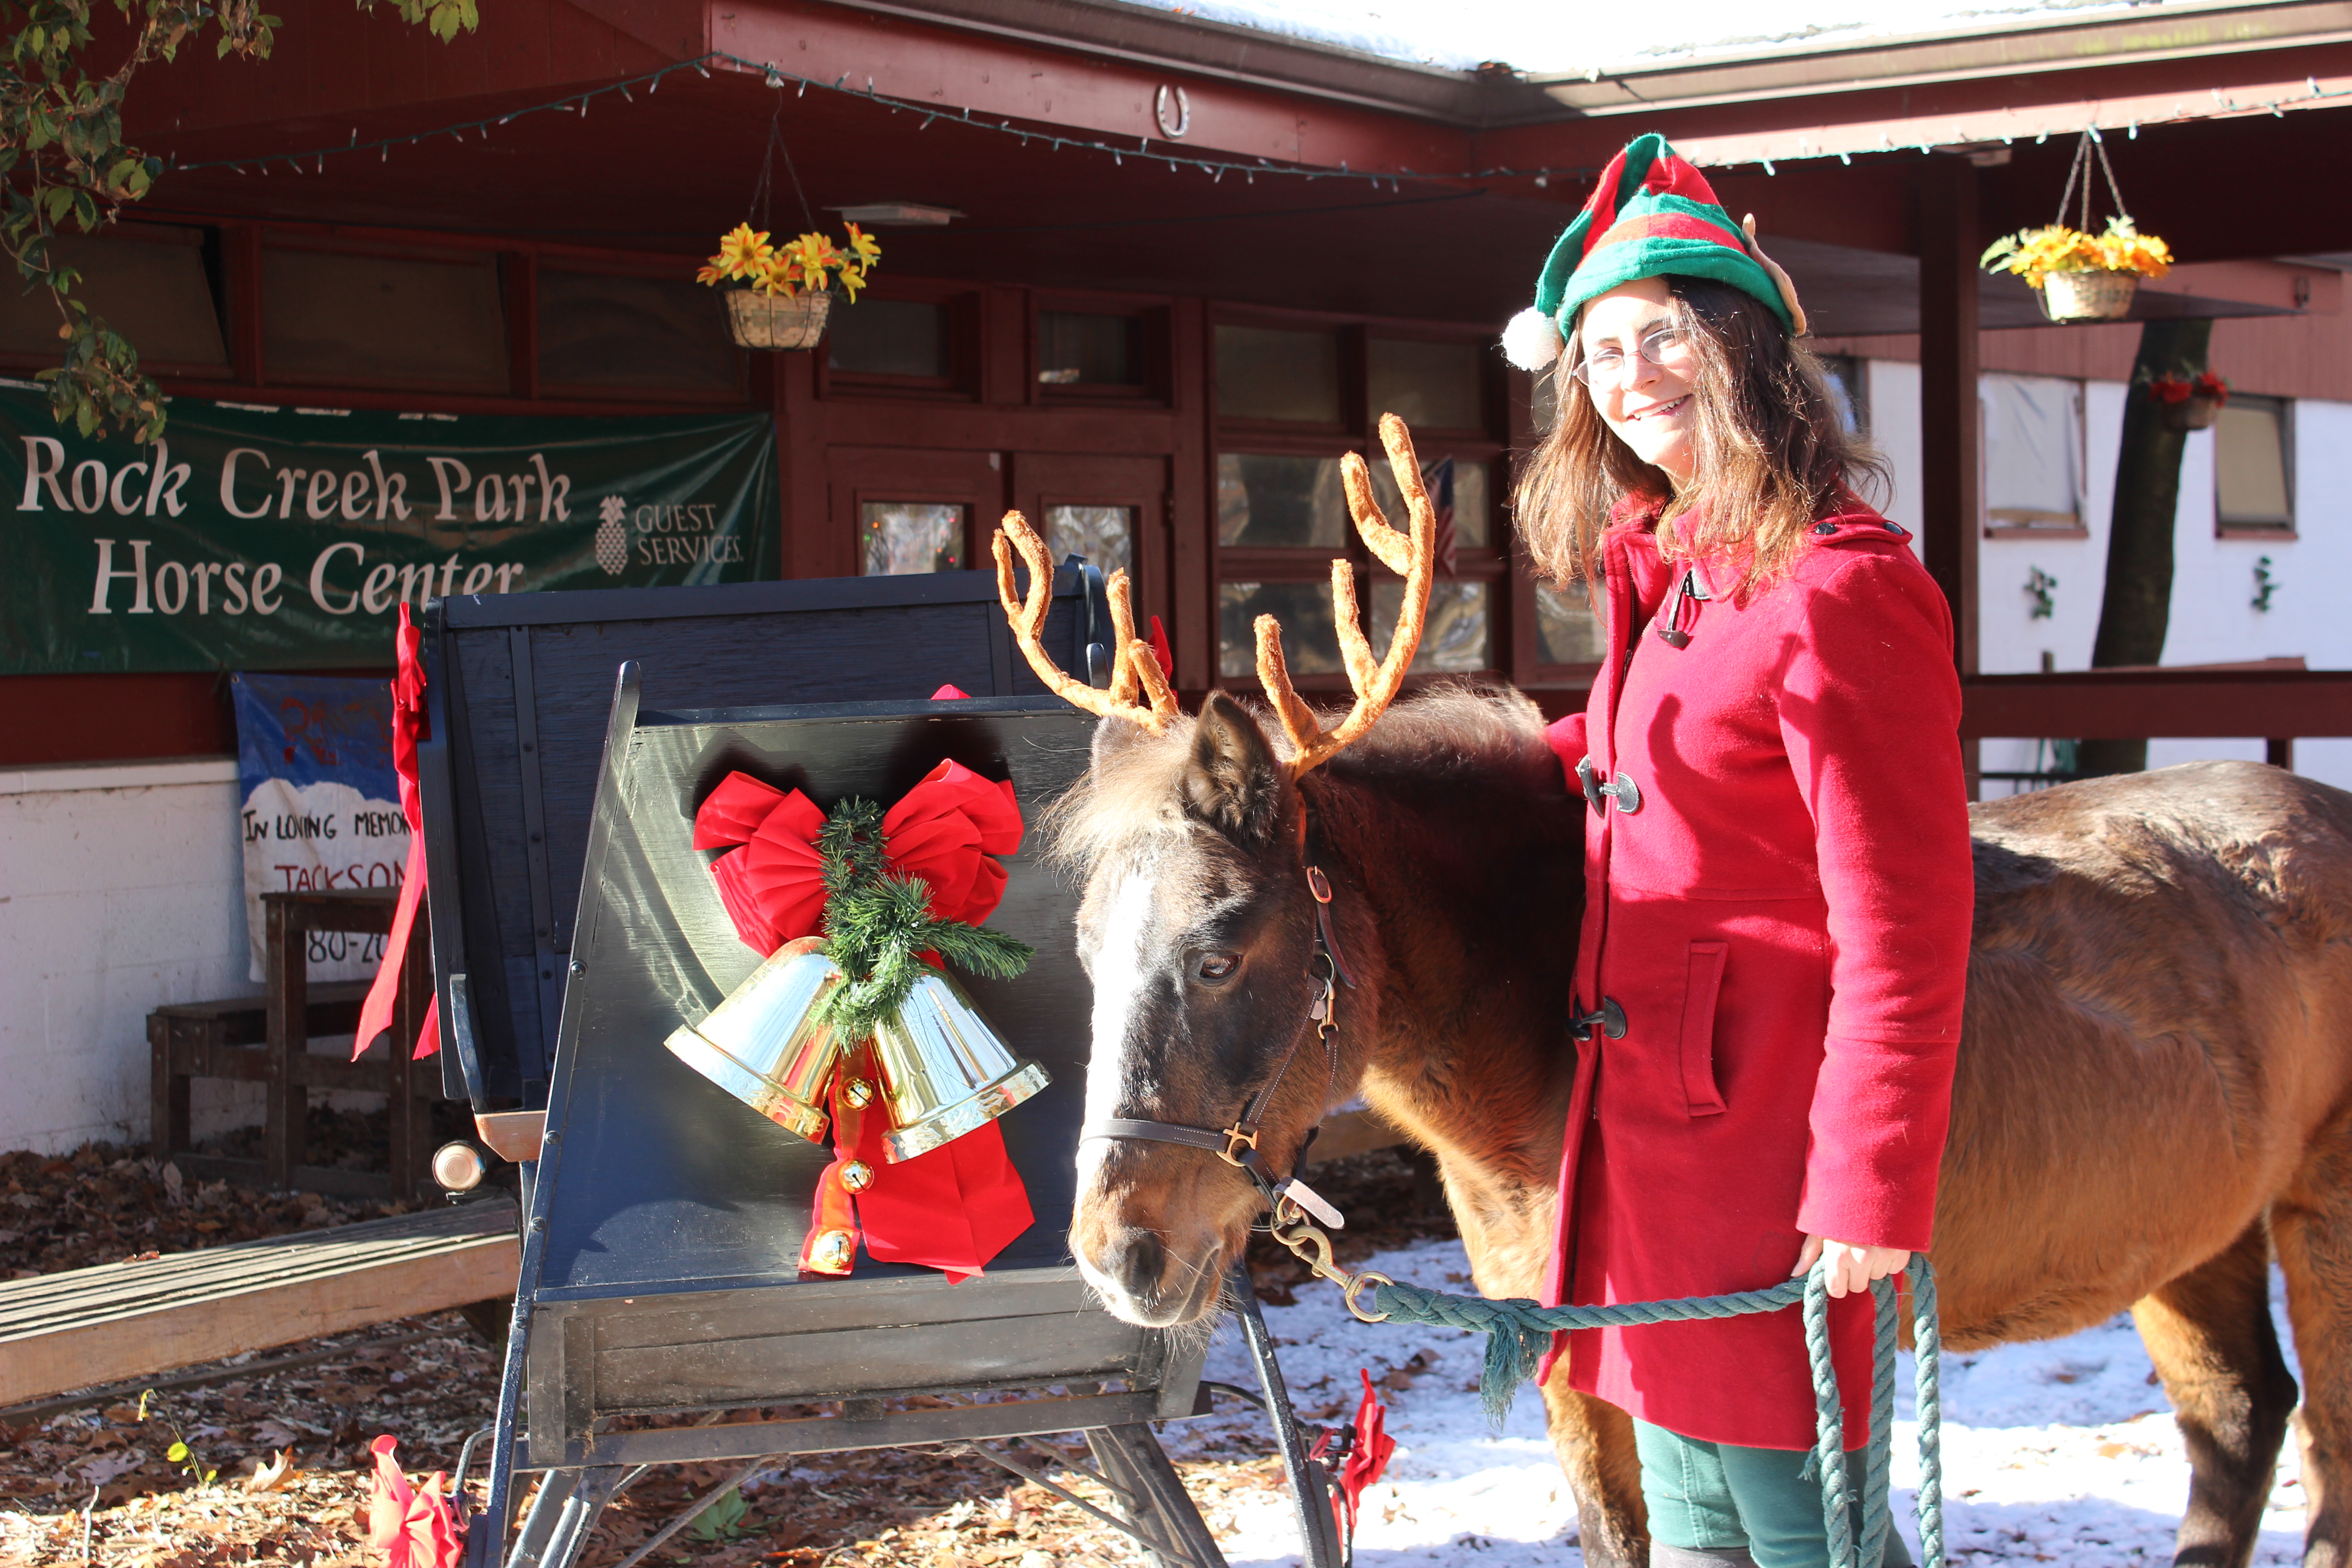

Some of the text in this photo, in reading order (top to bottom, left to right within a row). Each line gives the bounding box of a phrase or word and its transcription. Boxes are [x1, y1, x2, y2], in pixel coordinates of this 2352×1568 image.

[16, 436, 571, 523] Rock Creek Park
[635, 504, 716, 533] GUEST
[88, 538, 524, 616] Horse Center
[276, 810, 337, 839] LOVING
